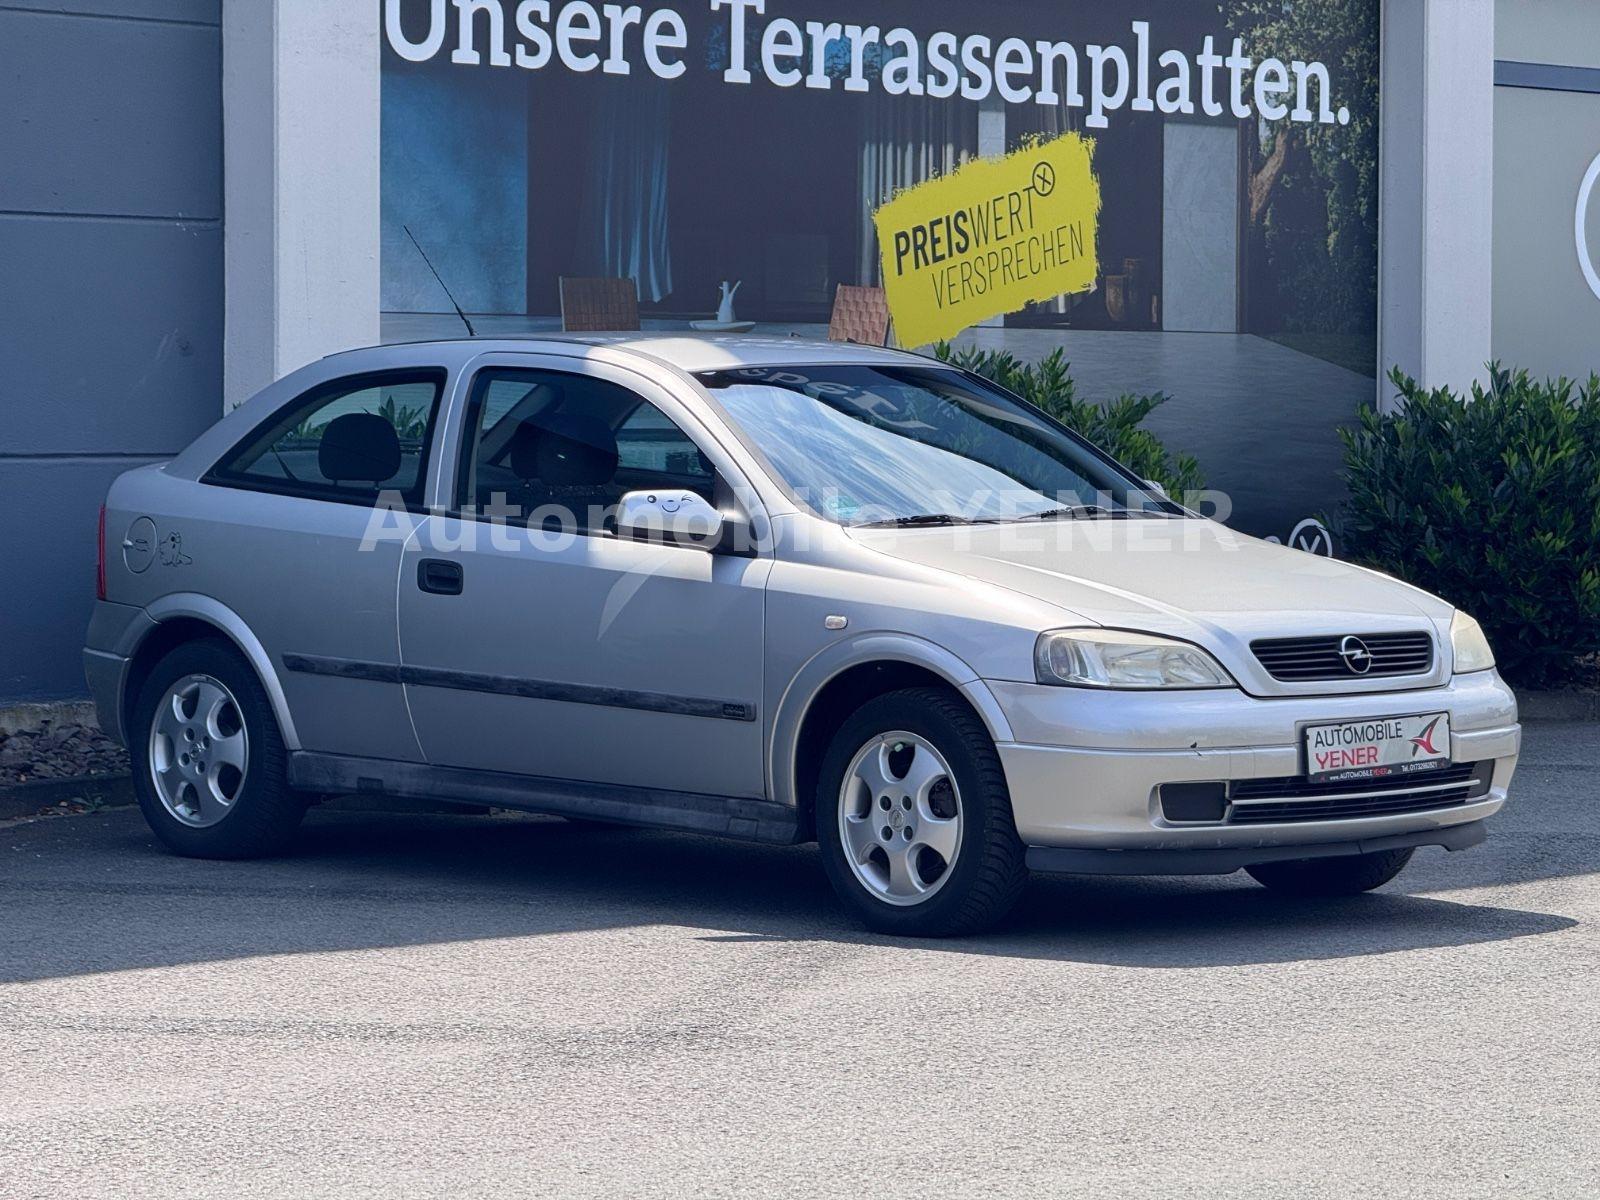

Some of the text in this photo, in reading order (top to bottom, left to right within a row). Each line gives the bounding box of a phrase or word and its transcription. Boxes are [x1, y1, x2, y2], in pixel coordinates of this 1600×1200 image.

[384, 0, 1351, 129] Unsere Terrassenplatten.
[894, 185, 1039, 276] PREISWERT
[931, 220, 1085, 310] VERSPRECHEN
[1314, 721, 1403, 749] AUTOMOBILE
[1315, 746, 1379, 770] YENER
